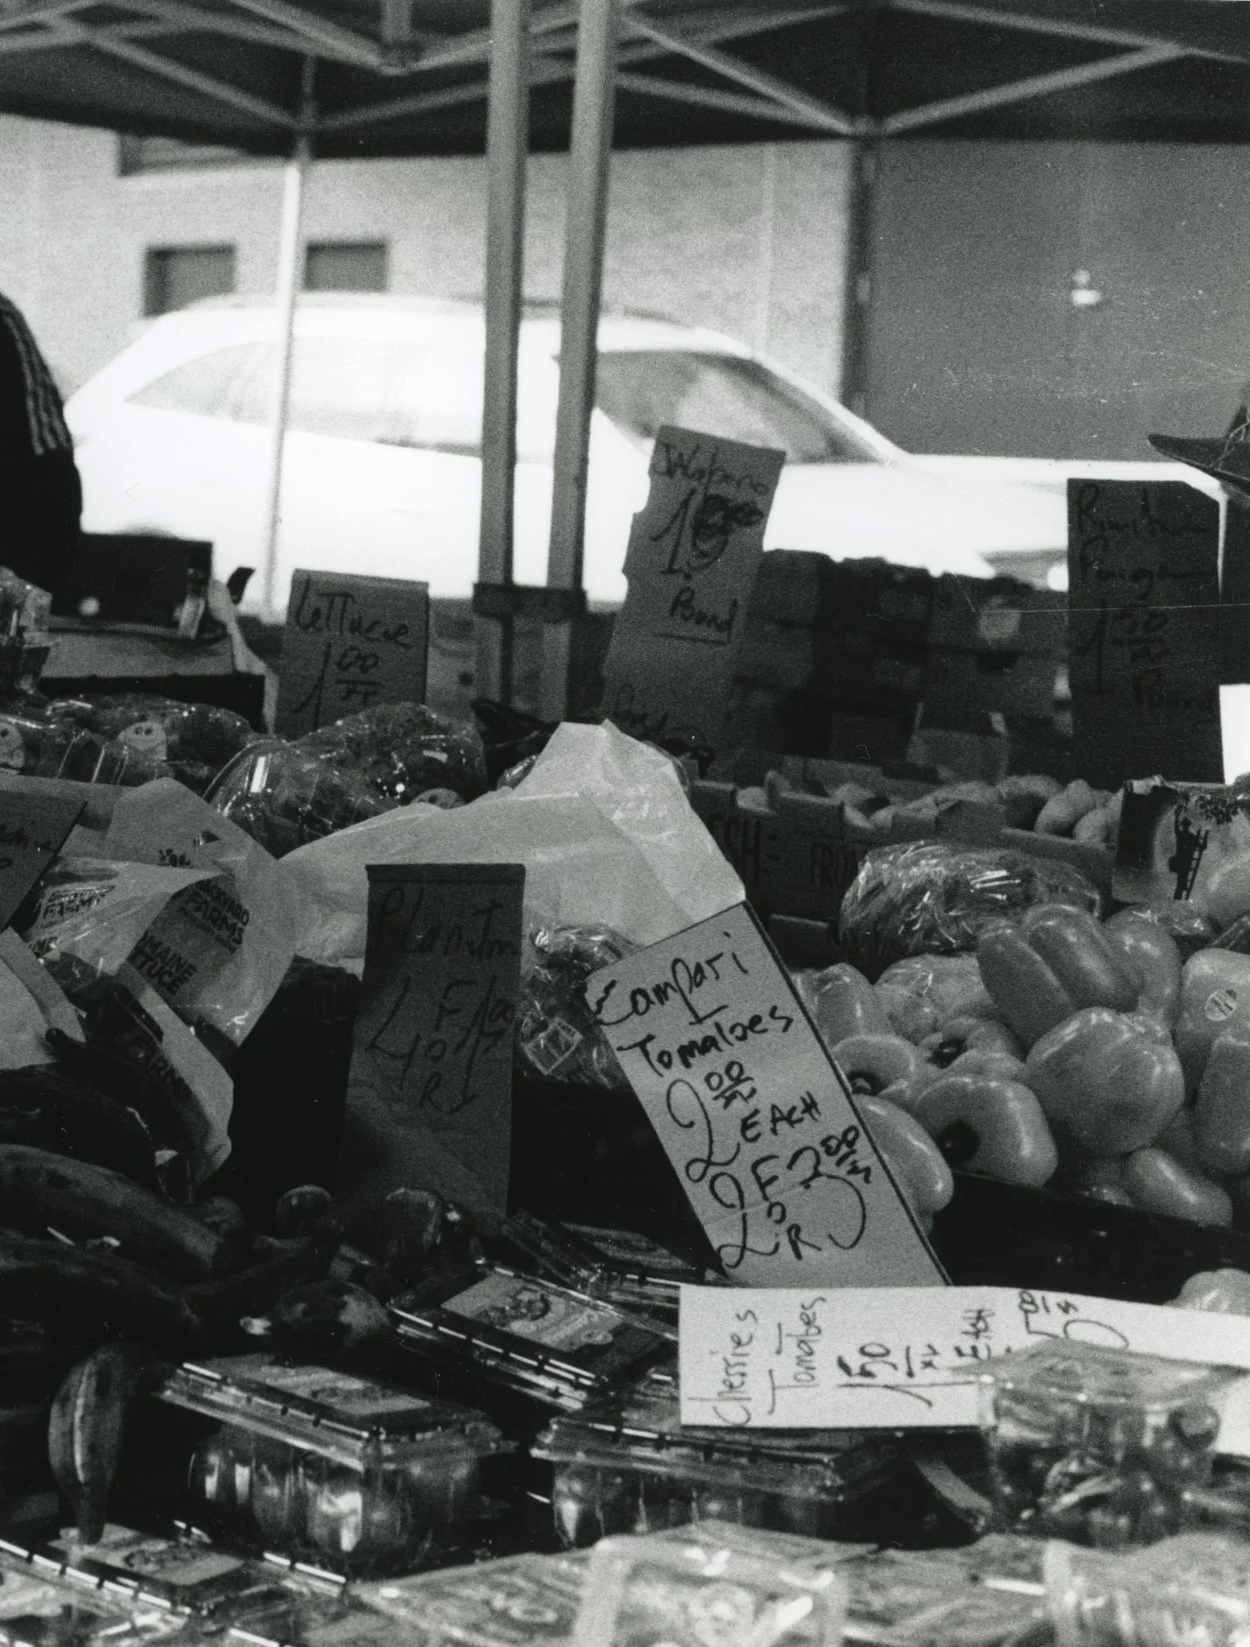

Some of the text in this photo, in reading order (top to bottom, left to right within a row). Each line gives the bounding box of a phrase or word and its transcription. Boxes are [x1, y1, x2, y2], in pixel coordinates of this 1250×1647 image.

[185, 890, 245, 945] FARMS
[128, 946, 180, 997] TTUCE
[138, 930, 198, 977] MAINE
[596, 932, 749, 1027] Campari
[687, 1308, 758, 1427] Cherries
